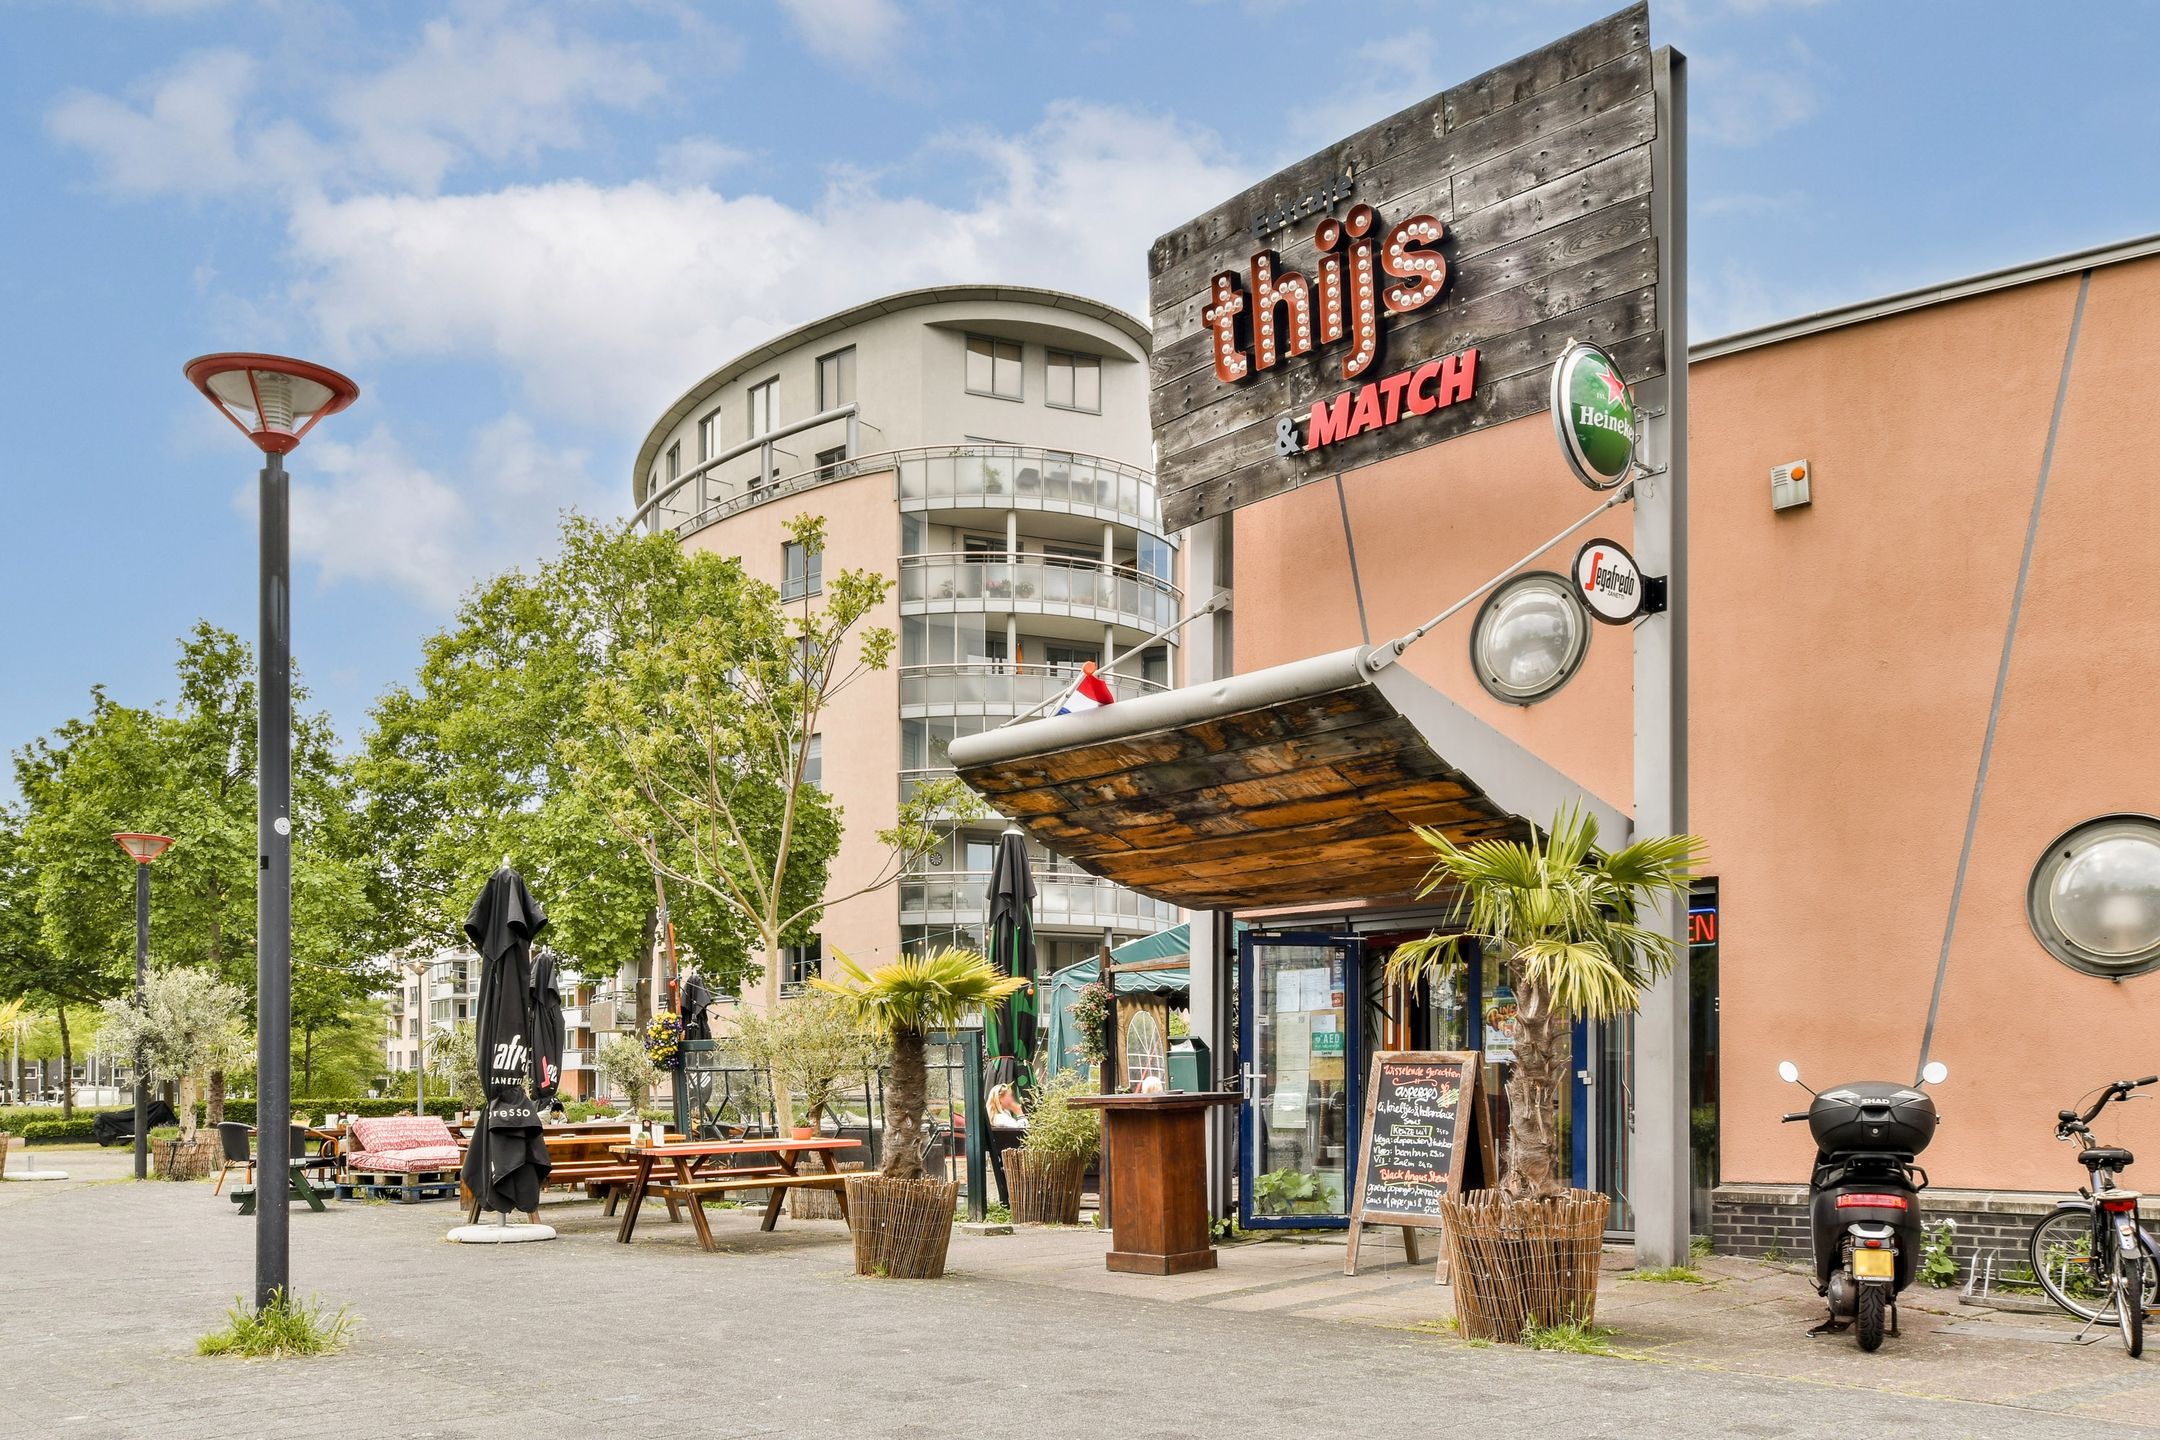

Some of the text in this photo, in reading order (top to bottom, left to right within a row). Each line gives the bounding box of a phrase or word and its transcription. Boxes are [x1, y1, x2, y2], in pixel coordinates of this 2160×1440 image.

[1202, 204, 1450, 383] thijs
[1275, 348, 1480, 457] & MATCH
[1579, 405, 1634, 441] Heineke
[1585, 552, 1635, 596] Segafredo
[1688, 913, 1716, 942] EN
[1323, 1033, 1341, 1044] AED
